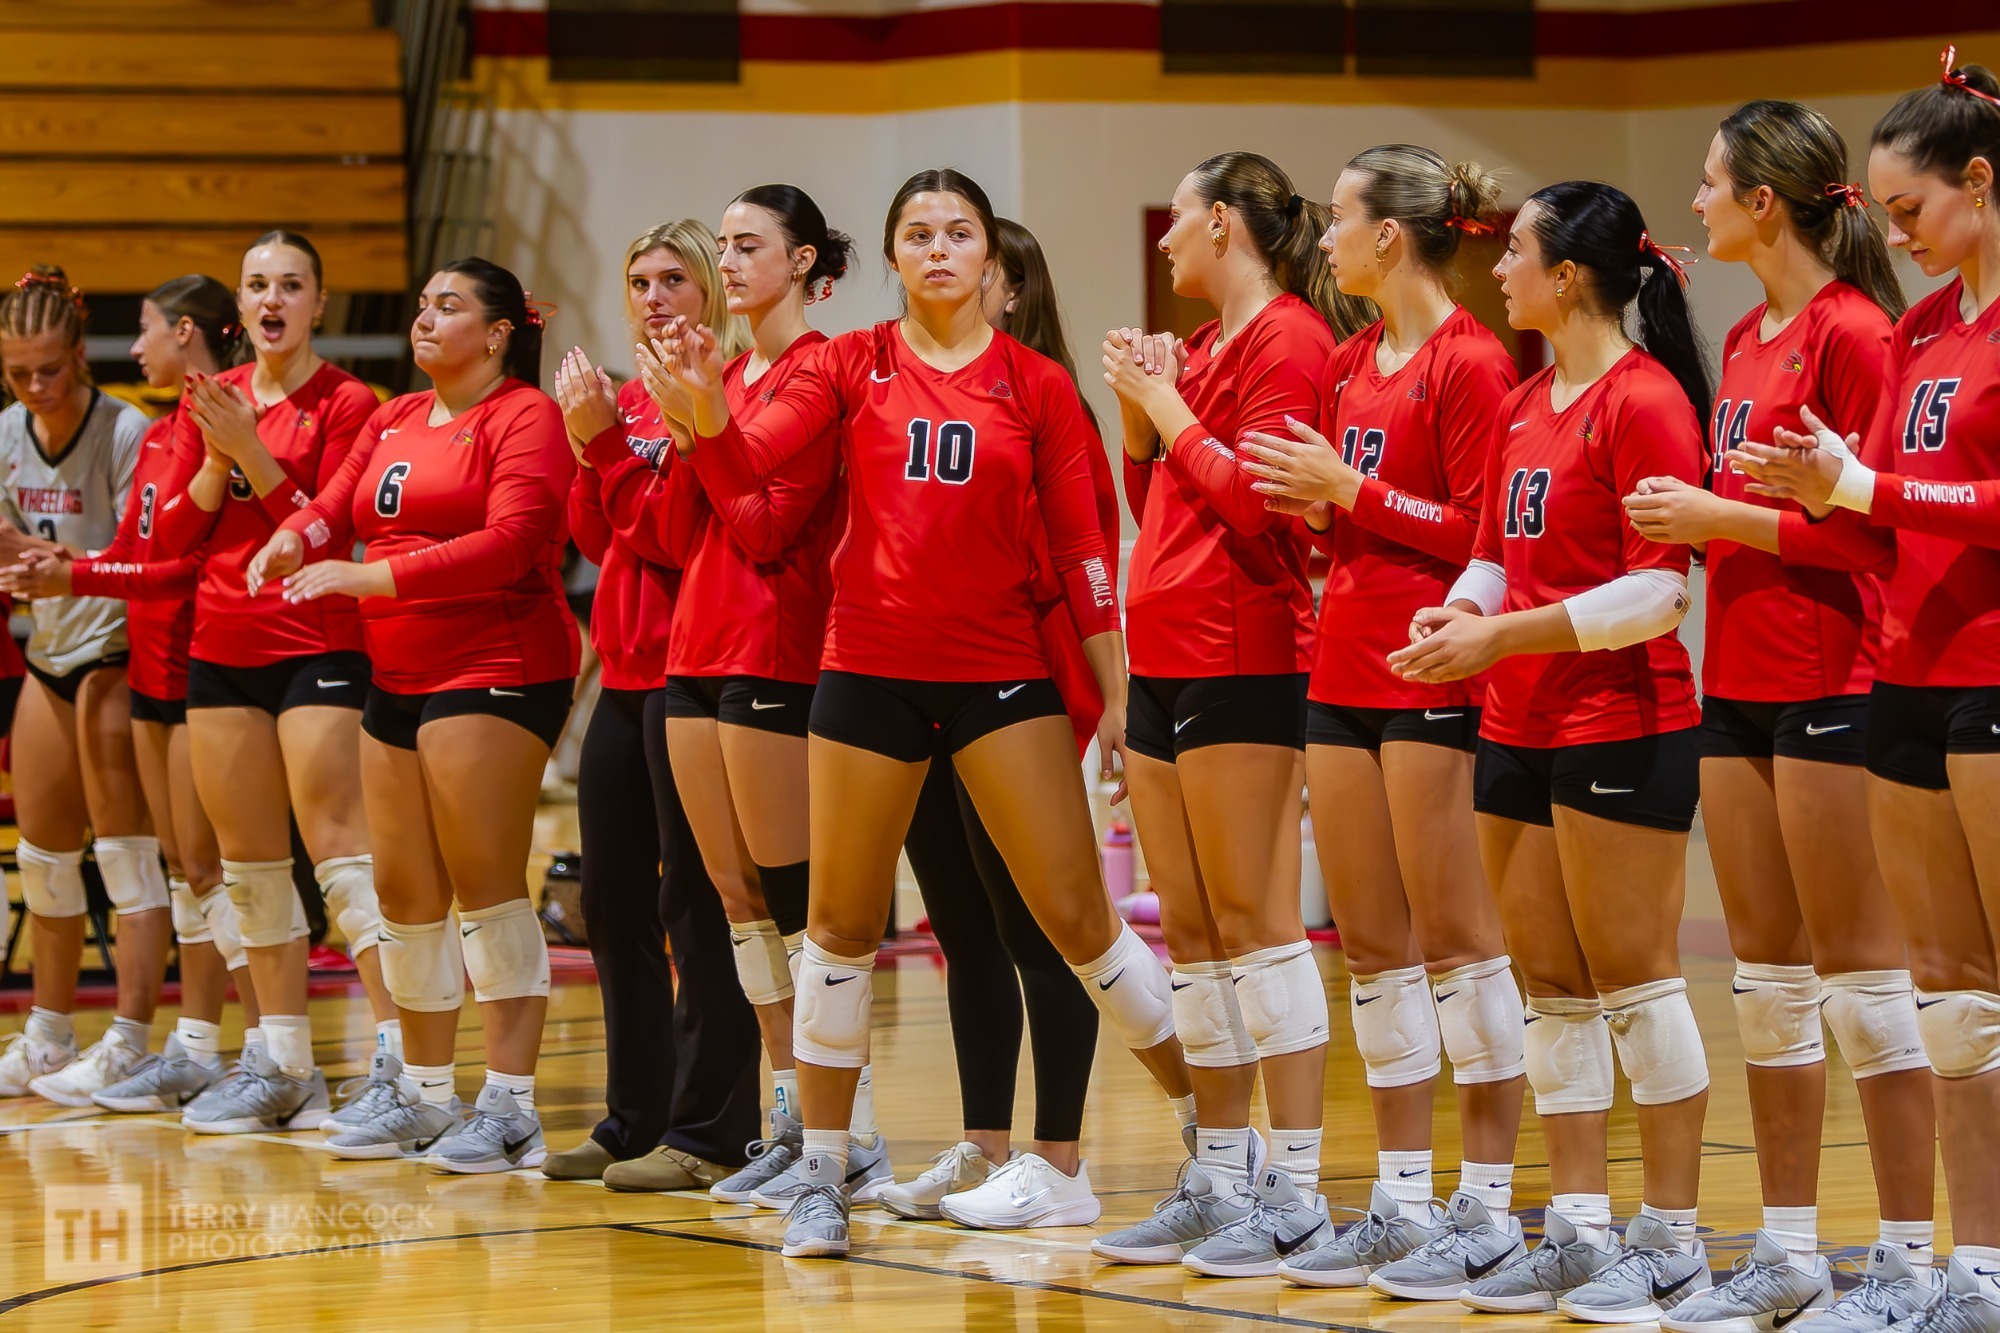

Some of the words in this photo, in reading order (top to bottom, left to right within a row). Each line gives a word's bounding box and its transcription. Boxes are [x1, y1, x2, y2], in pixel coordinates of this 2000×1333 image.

[1714, 399, 1754, 475] 14
[1903, 377, 1962, 453] 15
[904, 417, 976, 485] 10
[1341, 426, 1385, 481] 12
[374, 461, 412, 518] 6
[1504, 468, 1551, 538] 13
[1903, 480, 1976, 503] CARDINALS
